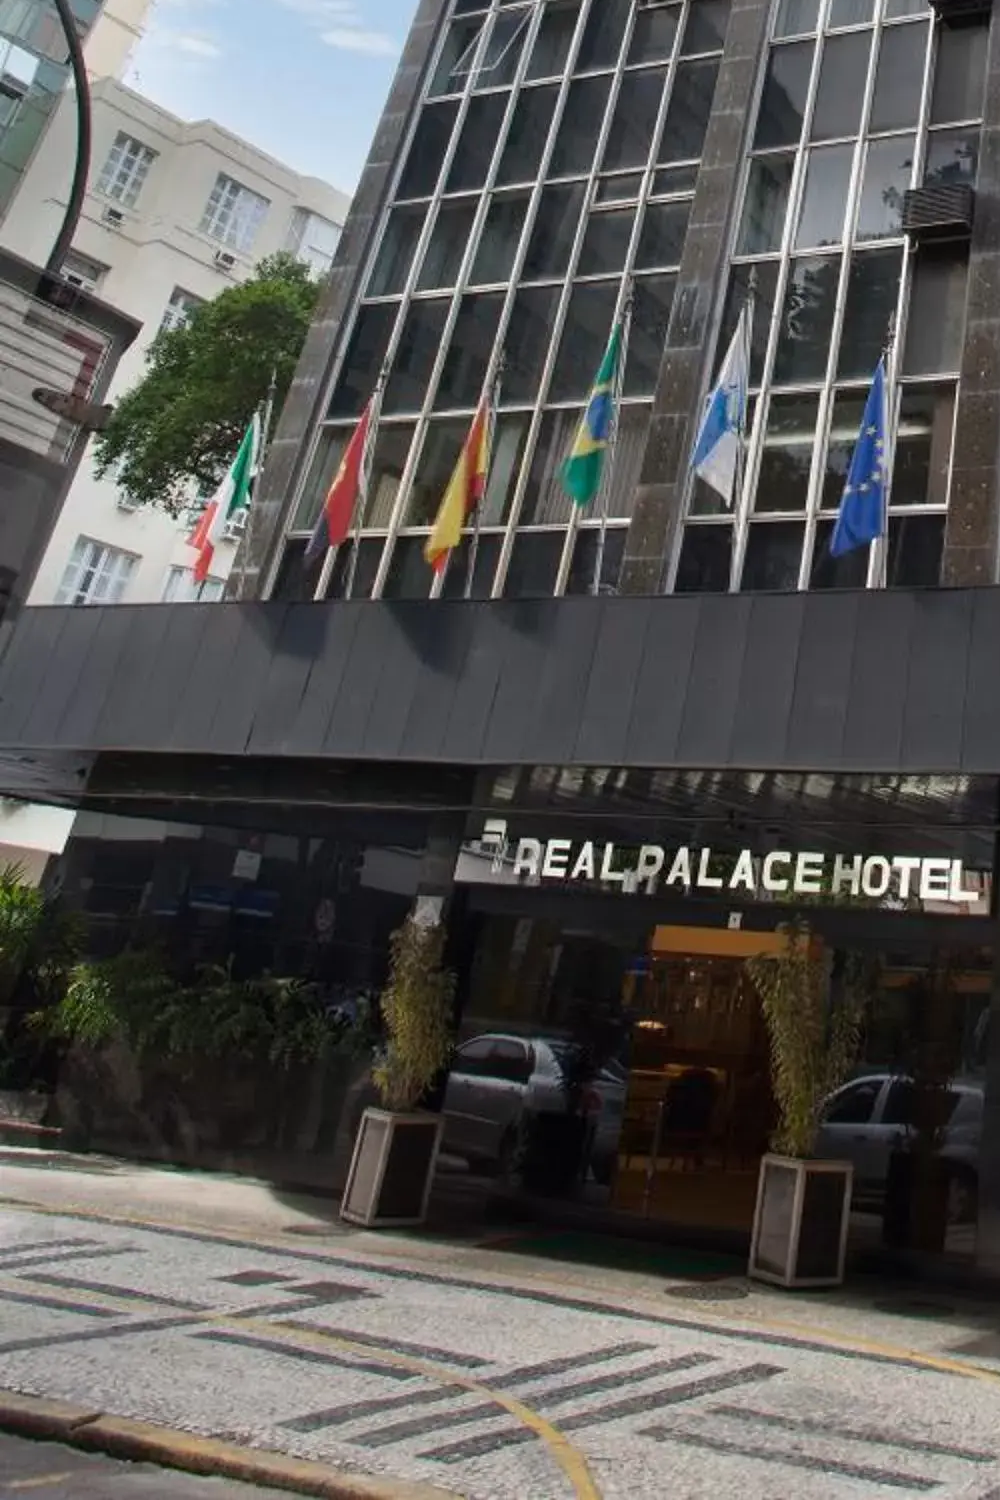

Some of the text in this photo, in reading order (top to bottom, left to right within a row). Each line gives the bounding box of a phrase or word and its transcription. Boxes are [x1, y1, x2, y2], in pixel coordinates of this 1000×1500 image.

[514, 837, 979, 901] REAL PALACE HOTEL
